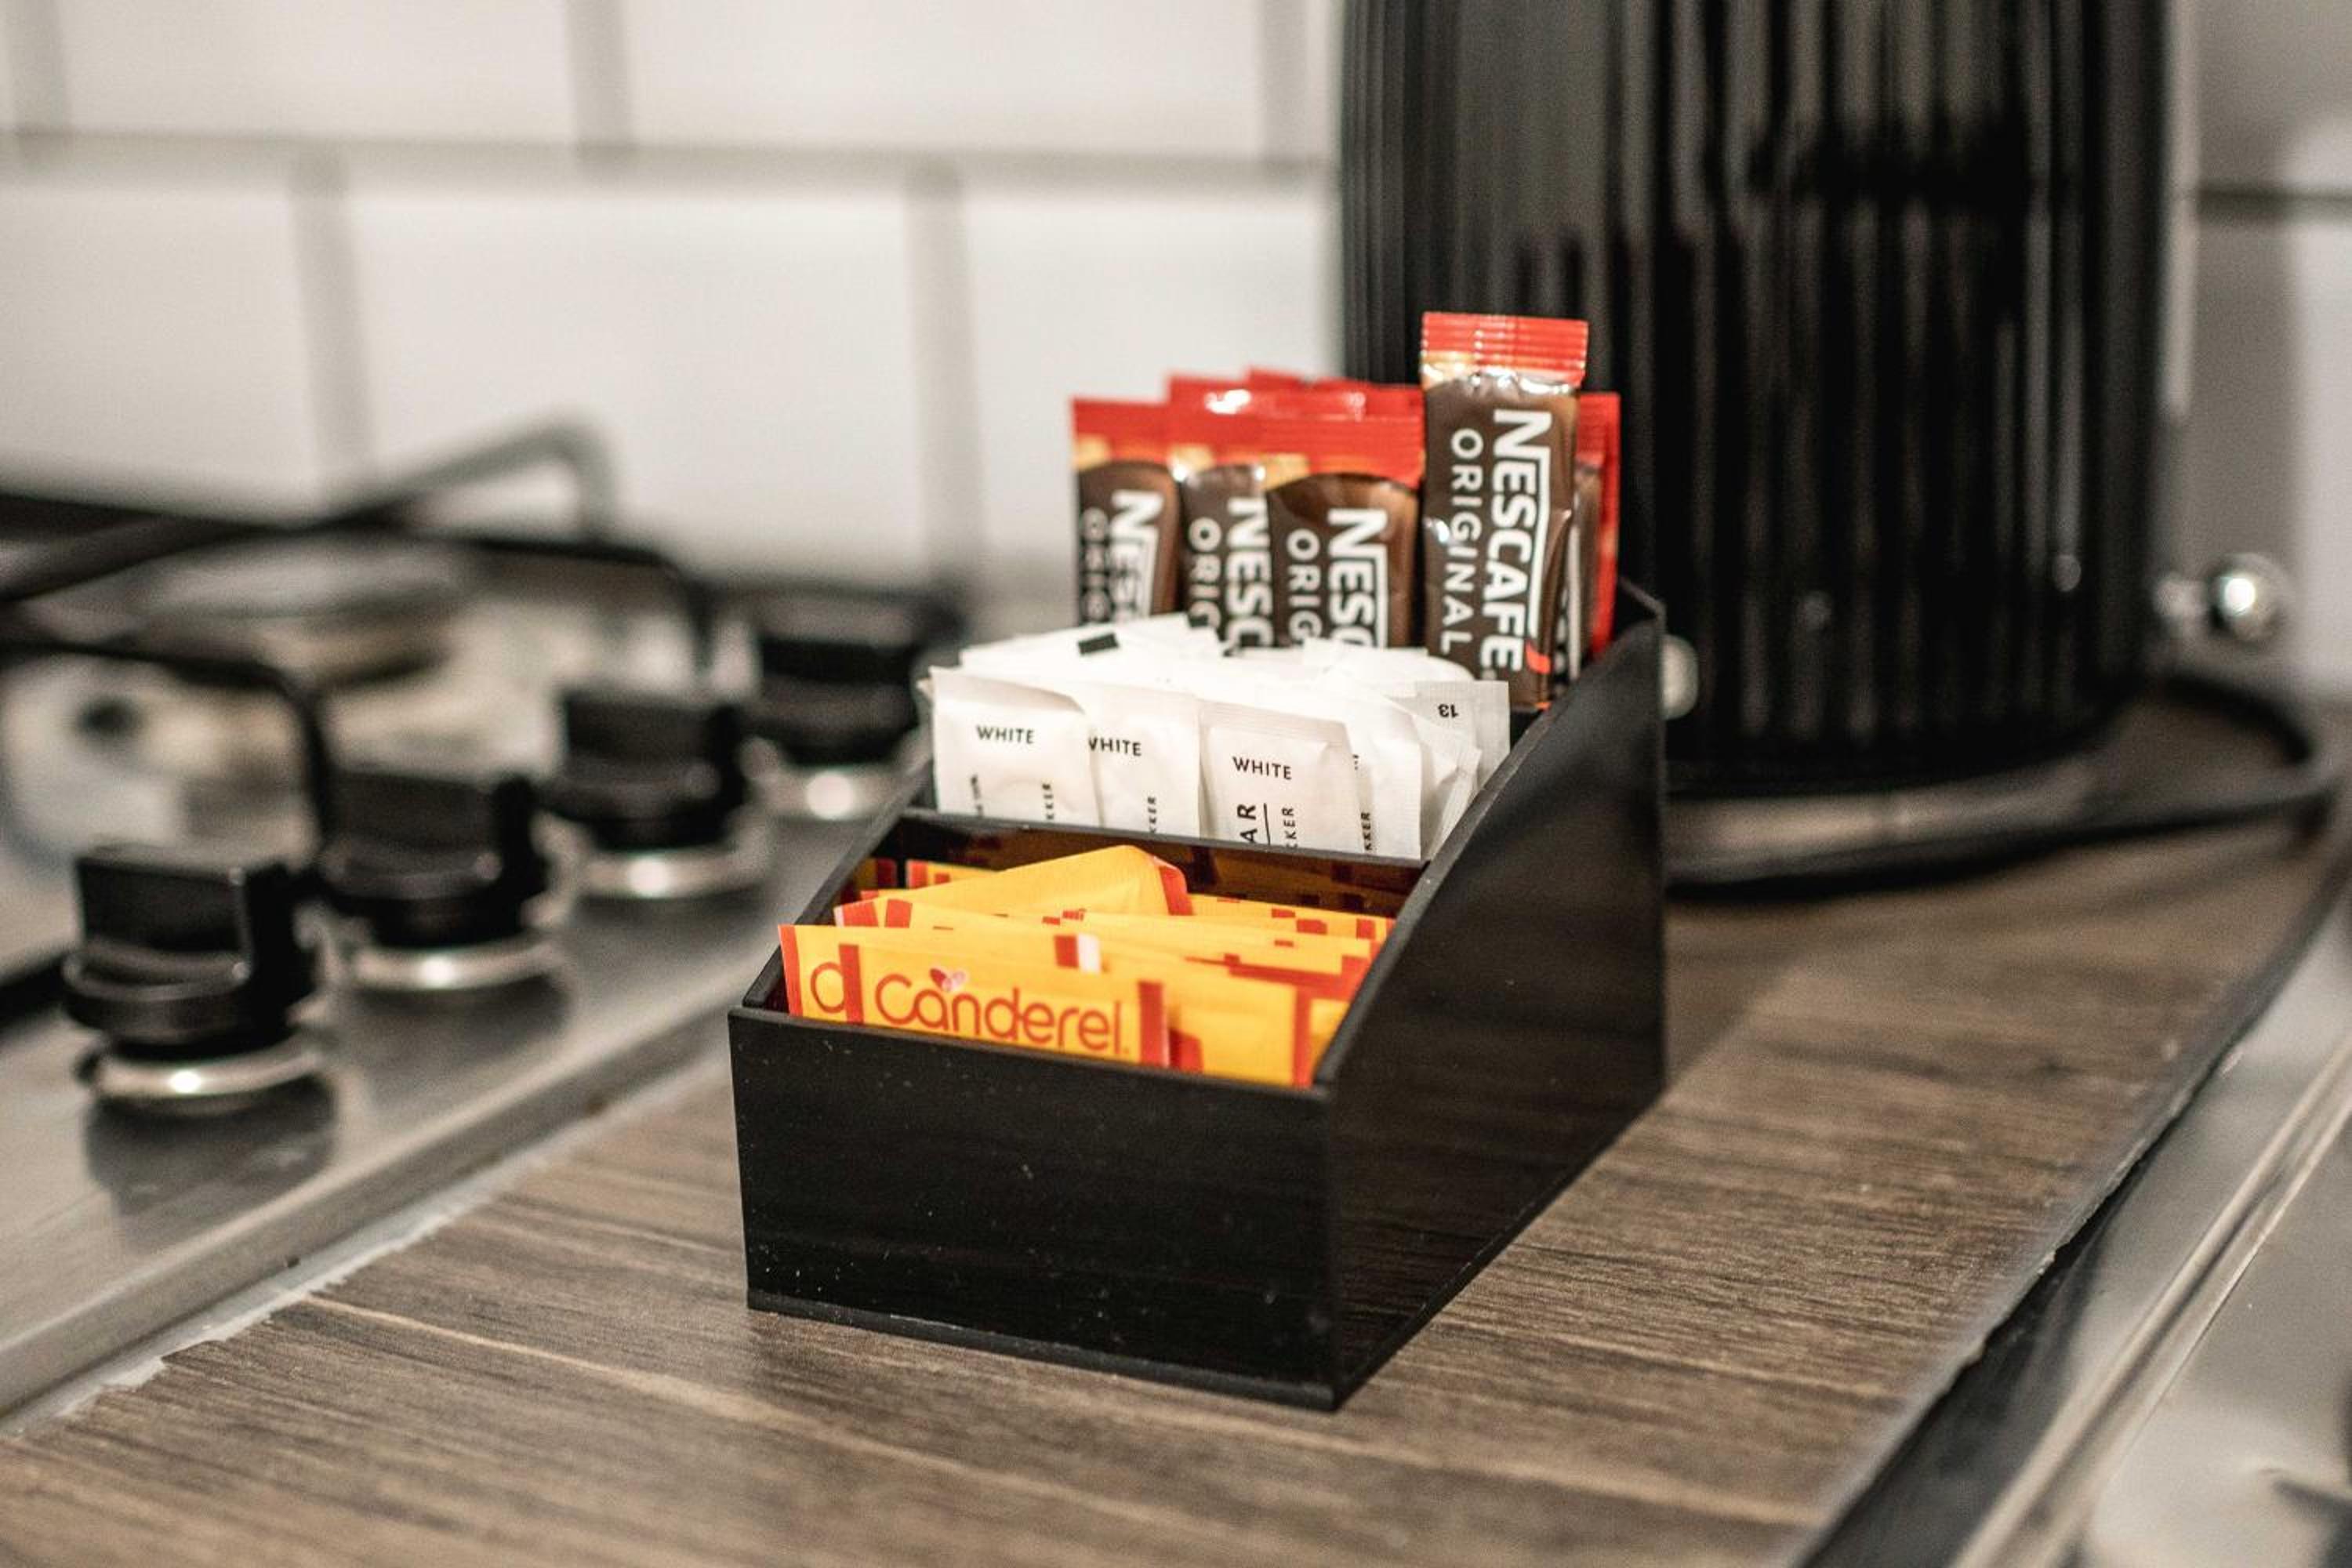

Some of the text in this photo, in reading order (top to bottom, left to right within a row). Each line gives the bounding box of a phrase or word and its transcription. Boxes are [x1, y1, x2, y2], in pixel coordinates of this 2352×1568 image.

[1441, 428, 1483, 654] ORIGINAL
[977, 725, 1035, 744] WHITE
[1232, 757, 1292, 780] WHITE
